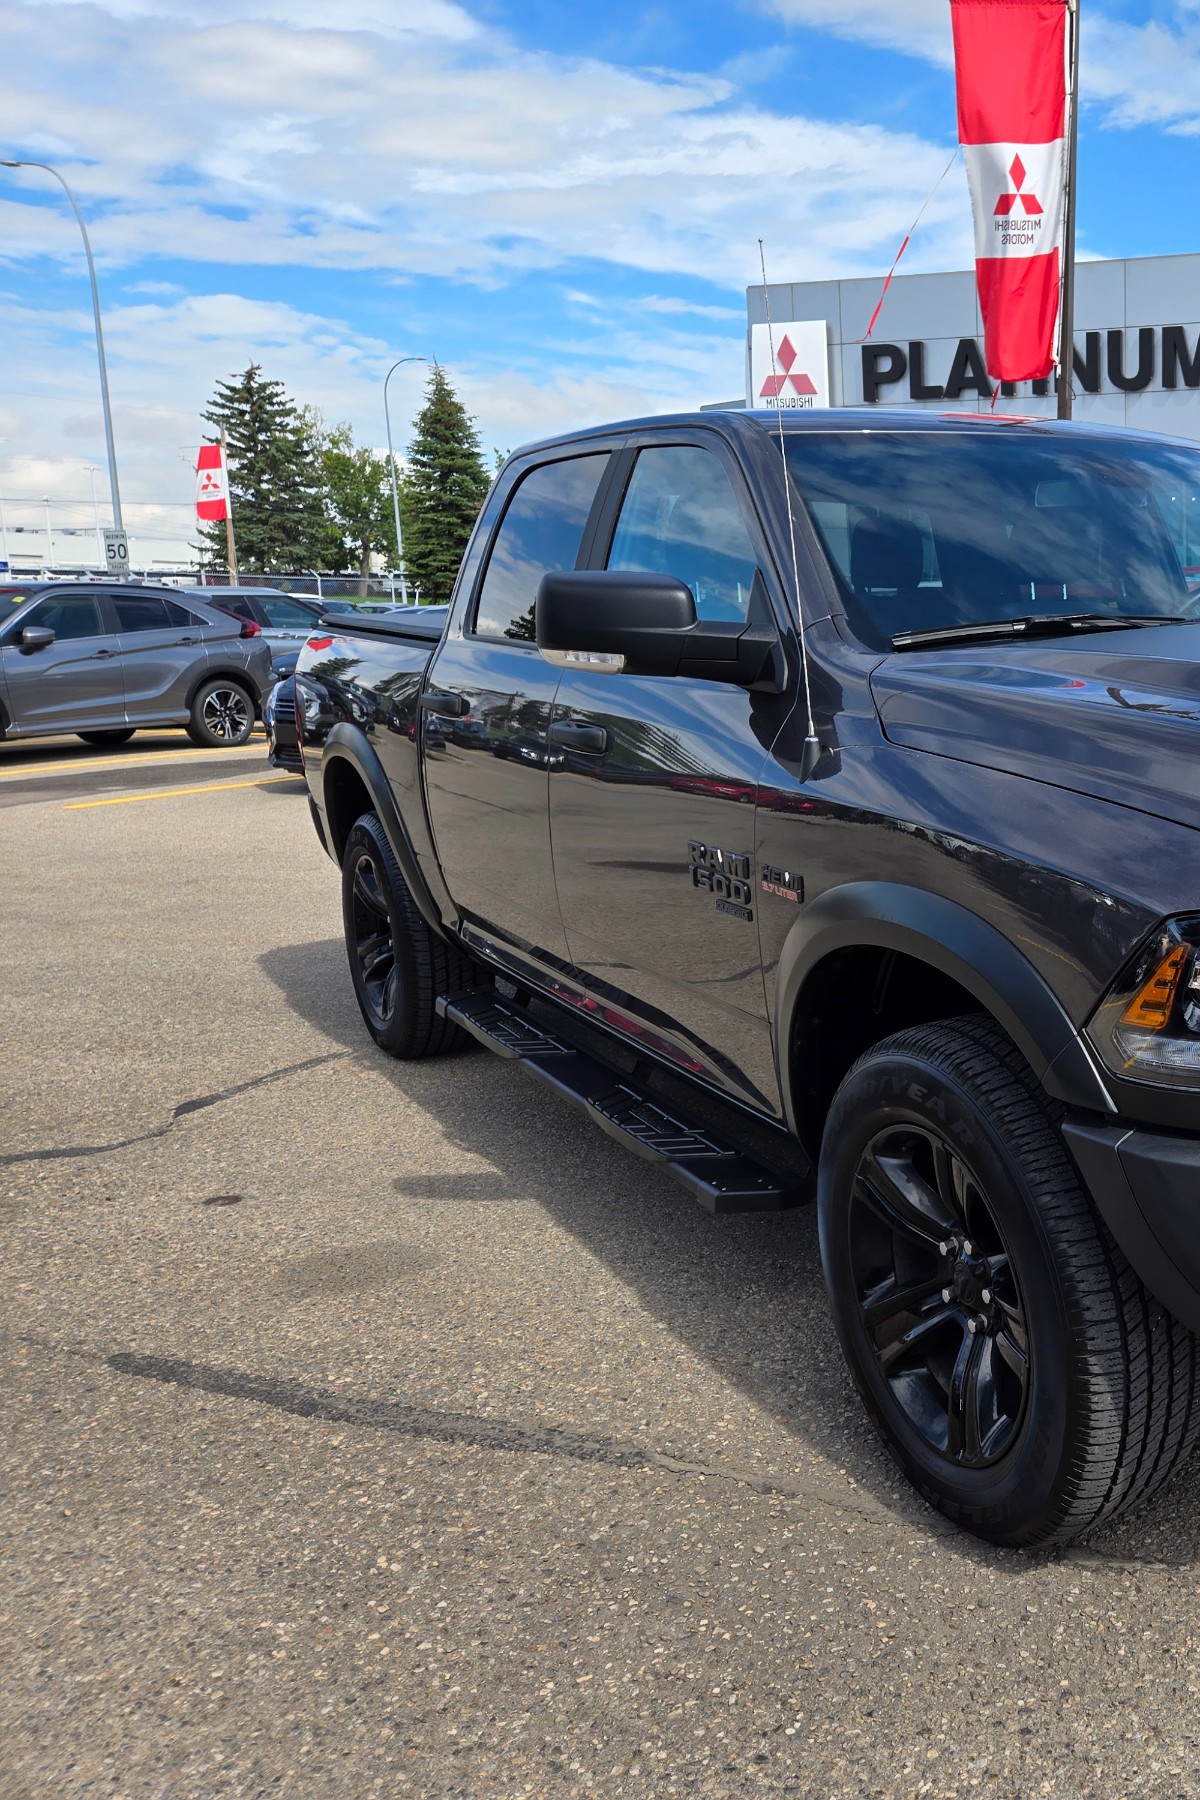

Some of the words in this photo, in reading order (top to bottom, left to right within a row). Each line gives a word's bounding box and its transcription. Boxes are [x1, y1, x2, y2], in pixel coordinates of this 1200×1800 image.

[766, 397, 813, 408] MITSUBISHI
[107, 543, 127, 559] 50
[687, 839, 750, 880] RAM
[688, 865, 751, 905] 1500
[762, 864, 803, 890] HEMI
[775, 886, 798, 902] LITER
